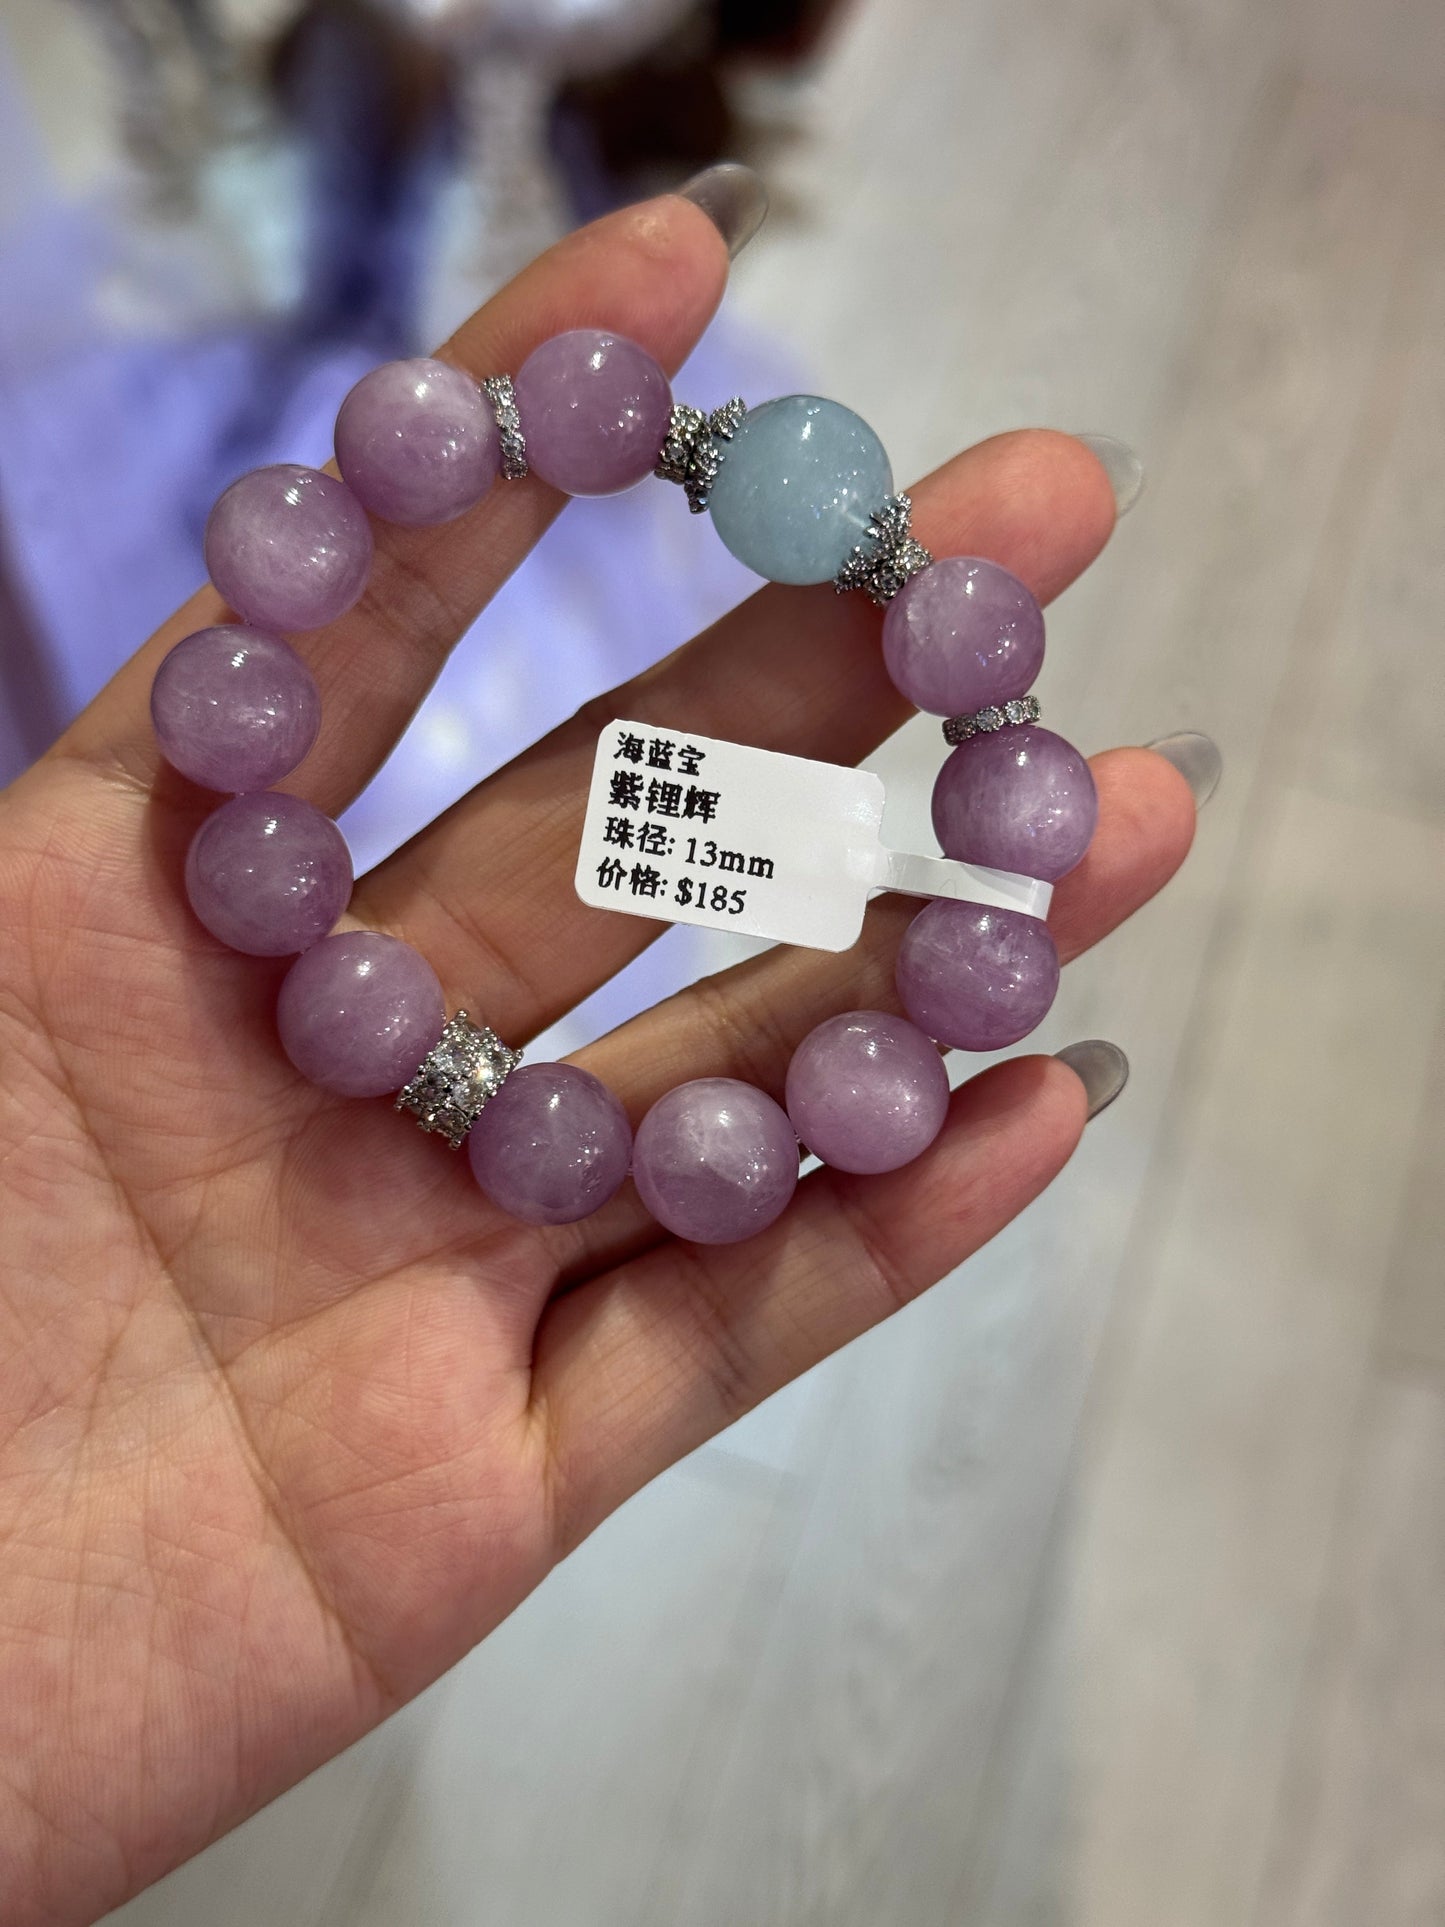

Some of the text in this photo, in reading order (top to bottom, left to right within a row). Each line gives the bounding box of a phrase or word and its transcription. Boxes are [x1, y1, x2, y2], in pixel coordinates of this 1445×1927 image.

[613, 731, 706, 776] 海蓝宝
[608, 770, 721, 823] 紫锂辉
[685, 837, 775, 879] 13mm
[674, 877, 748, 915] $185
